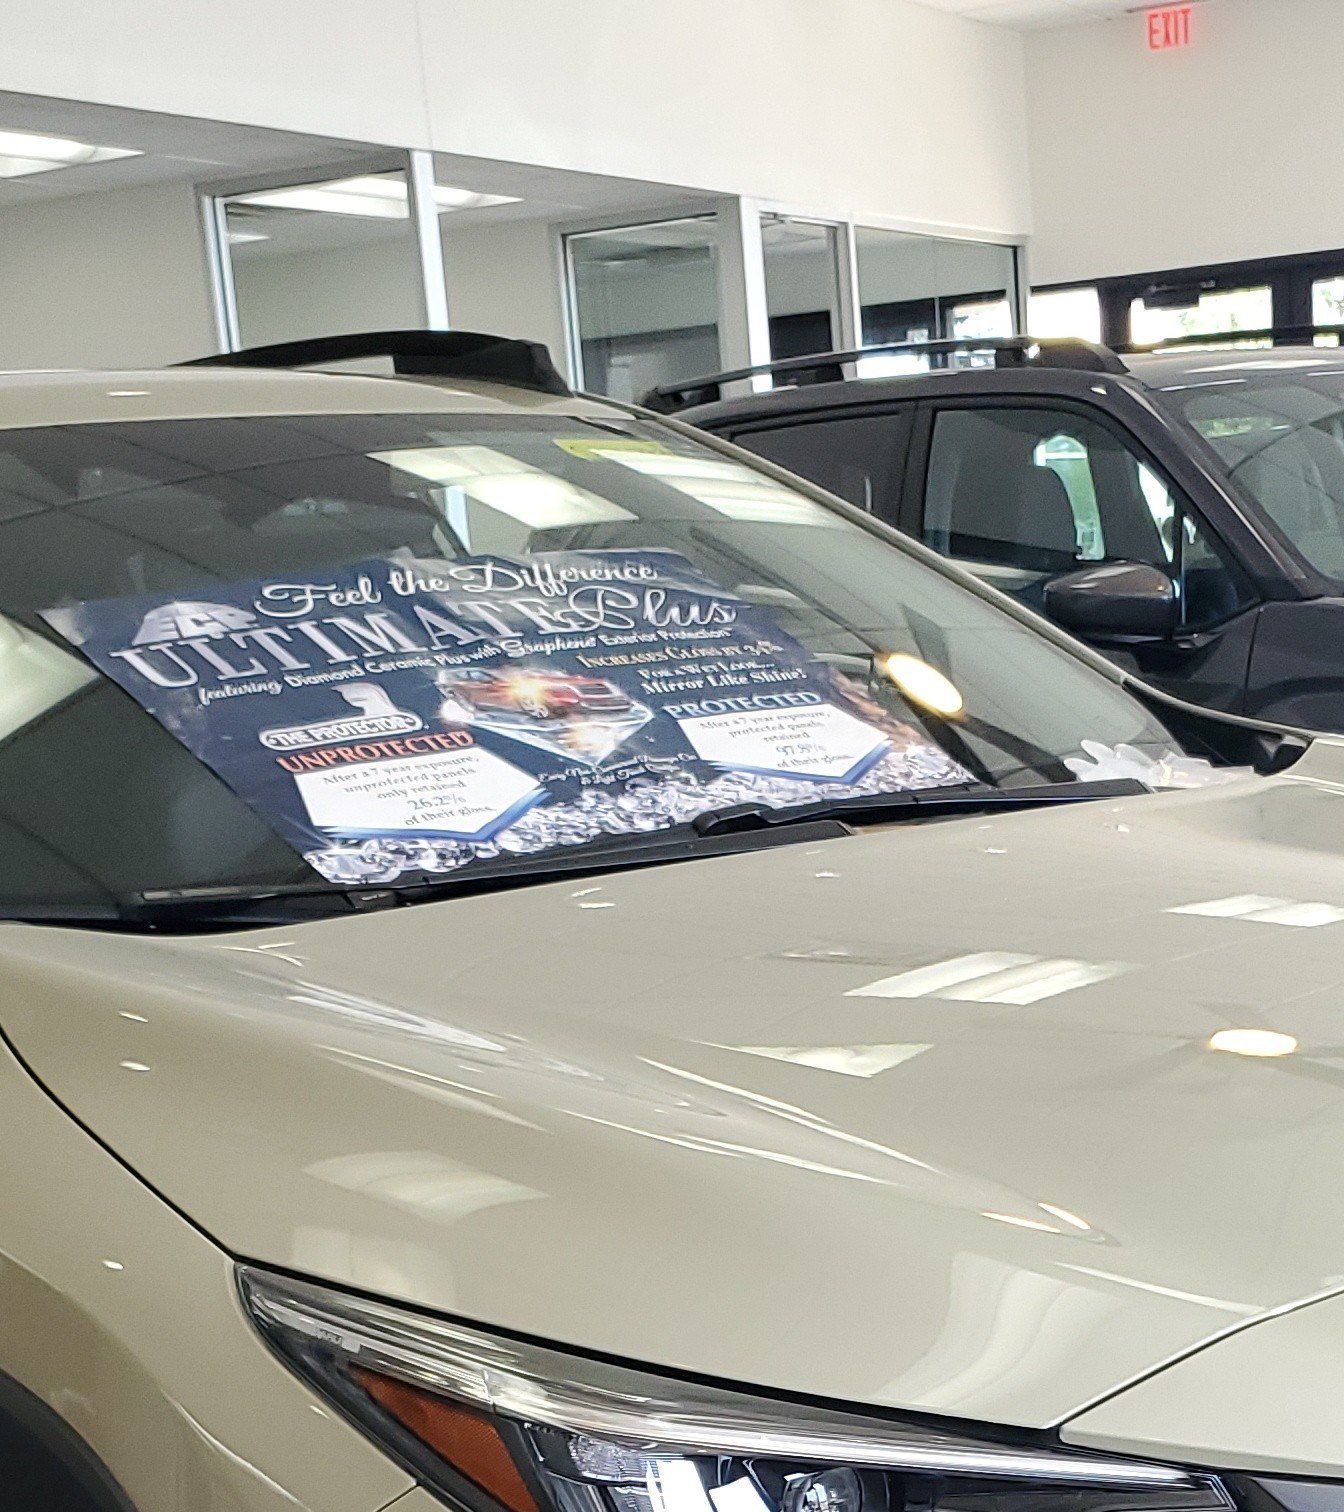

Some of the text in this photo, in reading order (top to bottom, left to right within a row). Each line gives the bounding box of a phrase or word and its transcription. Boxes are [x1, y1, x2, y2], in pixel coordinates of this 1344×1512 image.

[1147, 8, 1191, 50] EXIT
[254, 560, 659, 618] Feel the Difference
[109, 585, 739, 688] ULTIMATE Plus
[198, 679, 283, 706] featuring
[283, 660, 366, 688] Diamond
[364, 655, 436, 674] Ceramic
[434, 652, 471, 667] Plus
[469, 644, 502, 661] with
[500, 634, 597, 658] Graphene
[597, 631, 659, 646] Exterior
[640, 667, 808, 695] Mirror Like Shine!
[661, 691, 822, 719] PROTECTED
[274, 715, 411, 747] THE PROTECTOR
[699, 719, 730, 730] After
[749, 715, 775, 725] year
[727, 720, 825, 739] protected panels
[763, 731, 811, 743] retained
[276, 730, 474, 773] UNPROTECTED
[776, 758, 790, 769] of
[790, 755, 819, 767] their
[322, 772, 358, 786] After
[381, 764, 412, 776] year
[413, 755, 480, 771] exposure,
[342, 765, 477, 794] unprotected panels
[376, 779, 468, 800] only retained
[406, 793, 467, 811] 26.2%
[404, 814, 419, 827] of
[421, 808, 456, 822] their
